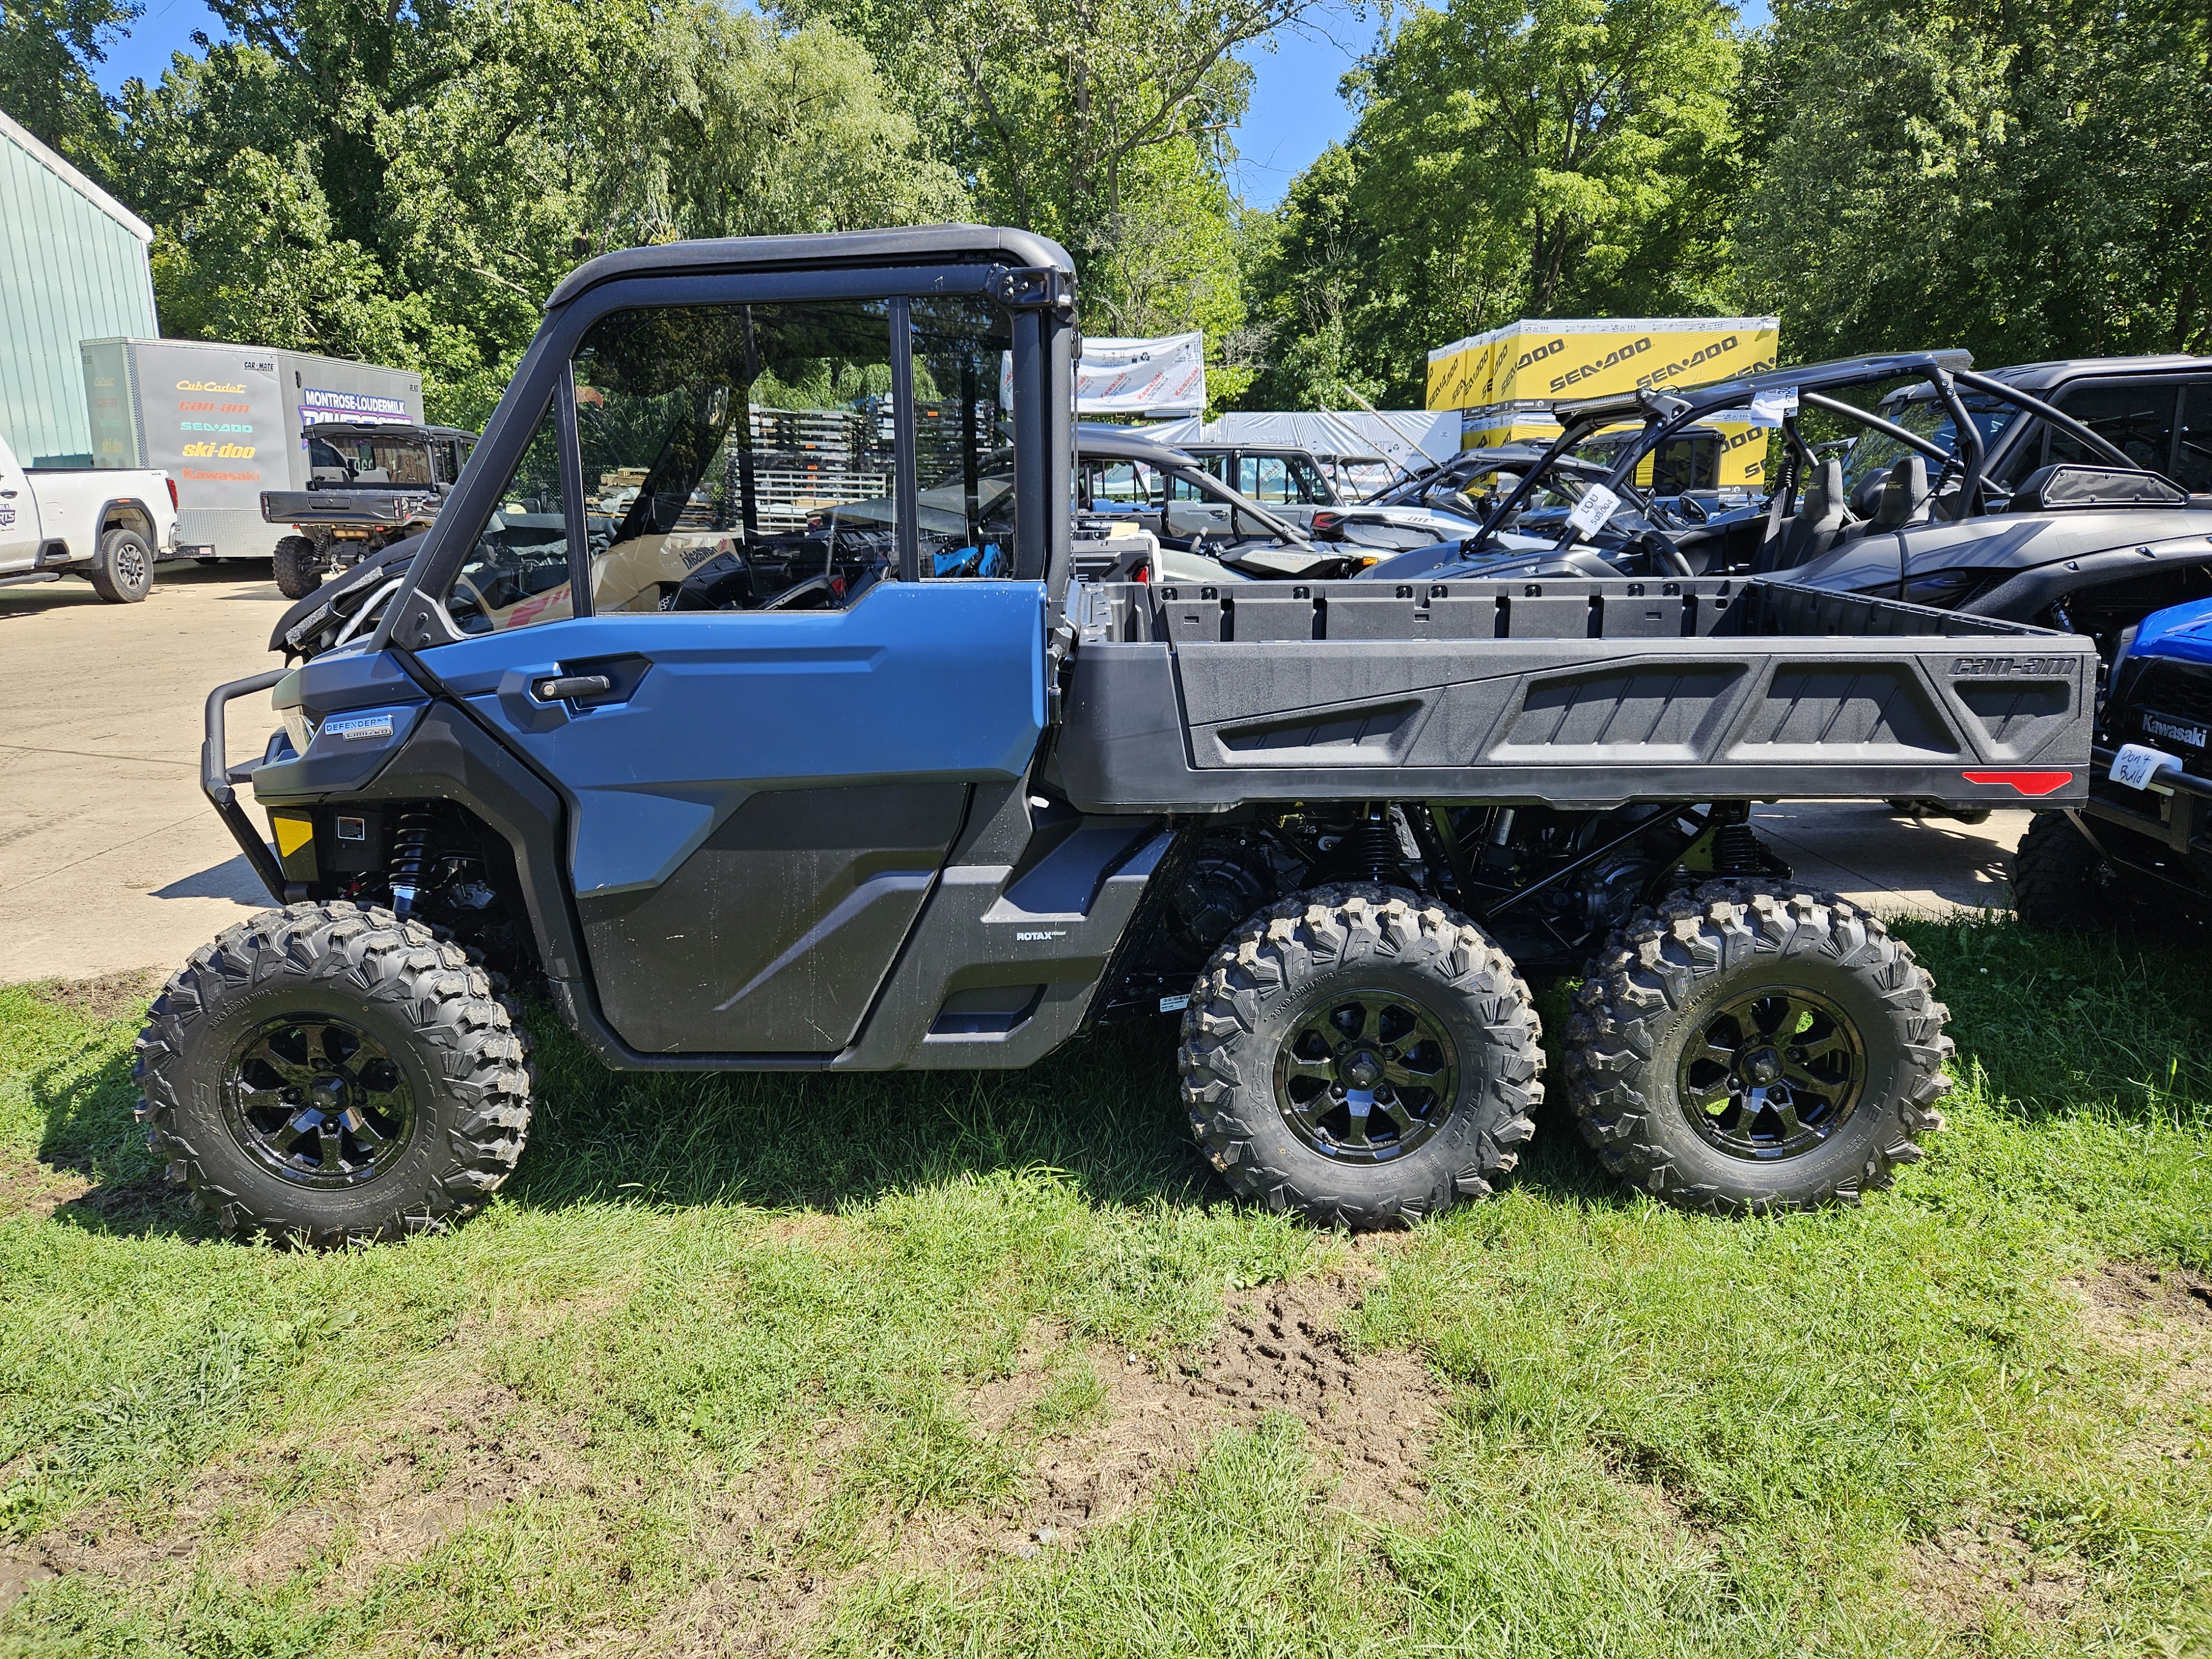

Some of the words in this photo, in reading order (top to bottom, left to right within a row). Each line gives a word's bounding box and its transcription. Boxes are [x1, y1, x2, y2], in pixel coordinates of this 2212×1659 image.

[1099, 372, 1126, 400] Kawasaki
[1119, 377, 1132, 392] VEHICLE
[1137, 372, 1163, 400] Kawasaki
[1156, 377, 1169, 392] VEHICLE
[1174, 367, 1199, 397] Kawasaki
[179, 401, 249, 413] can-am
[305, 390, 405, 415] MONTROSE-LOUDERMILK
[182, 442, 255, 458] ski-doo
[182, 468, 260, 481] Kawasaki
[1580, 494, 1599, 514] LOU
[1590, 499, 1613, 526] 503004
[1501, 557, 1541, 568] EDITION
[1948, 658, 2077, 676] can-am
[326, 719, 376, 731] DEFENDER
[2142, 714, 2207, 748] Kawasaki
[347, 729, 388, 738] LIMITED
[2122, 749, 2152, 764] Don't
[2120, 765, 2147, 784] Build
[1016, 932, 1052, 941] ROTAX
